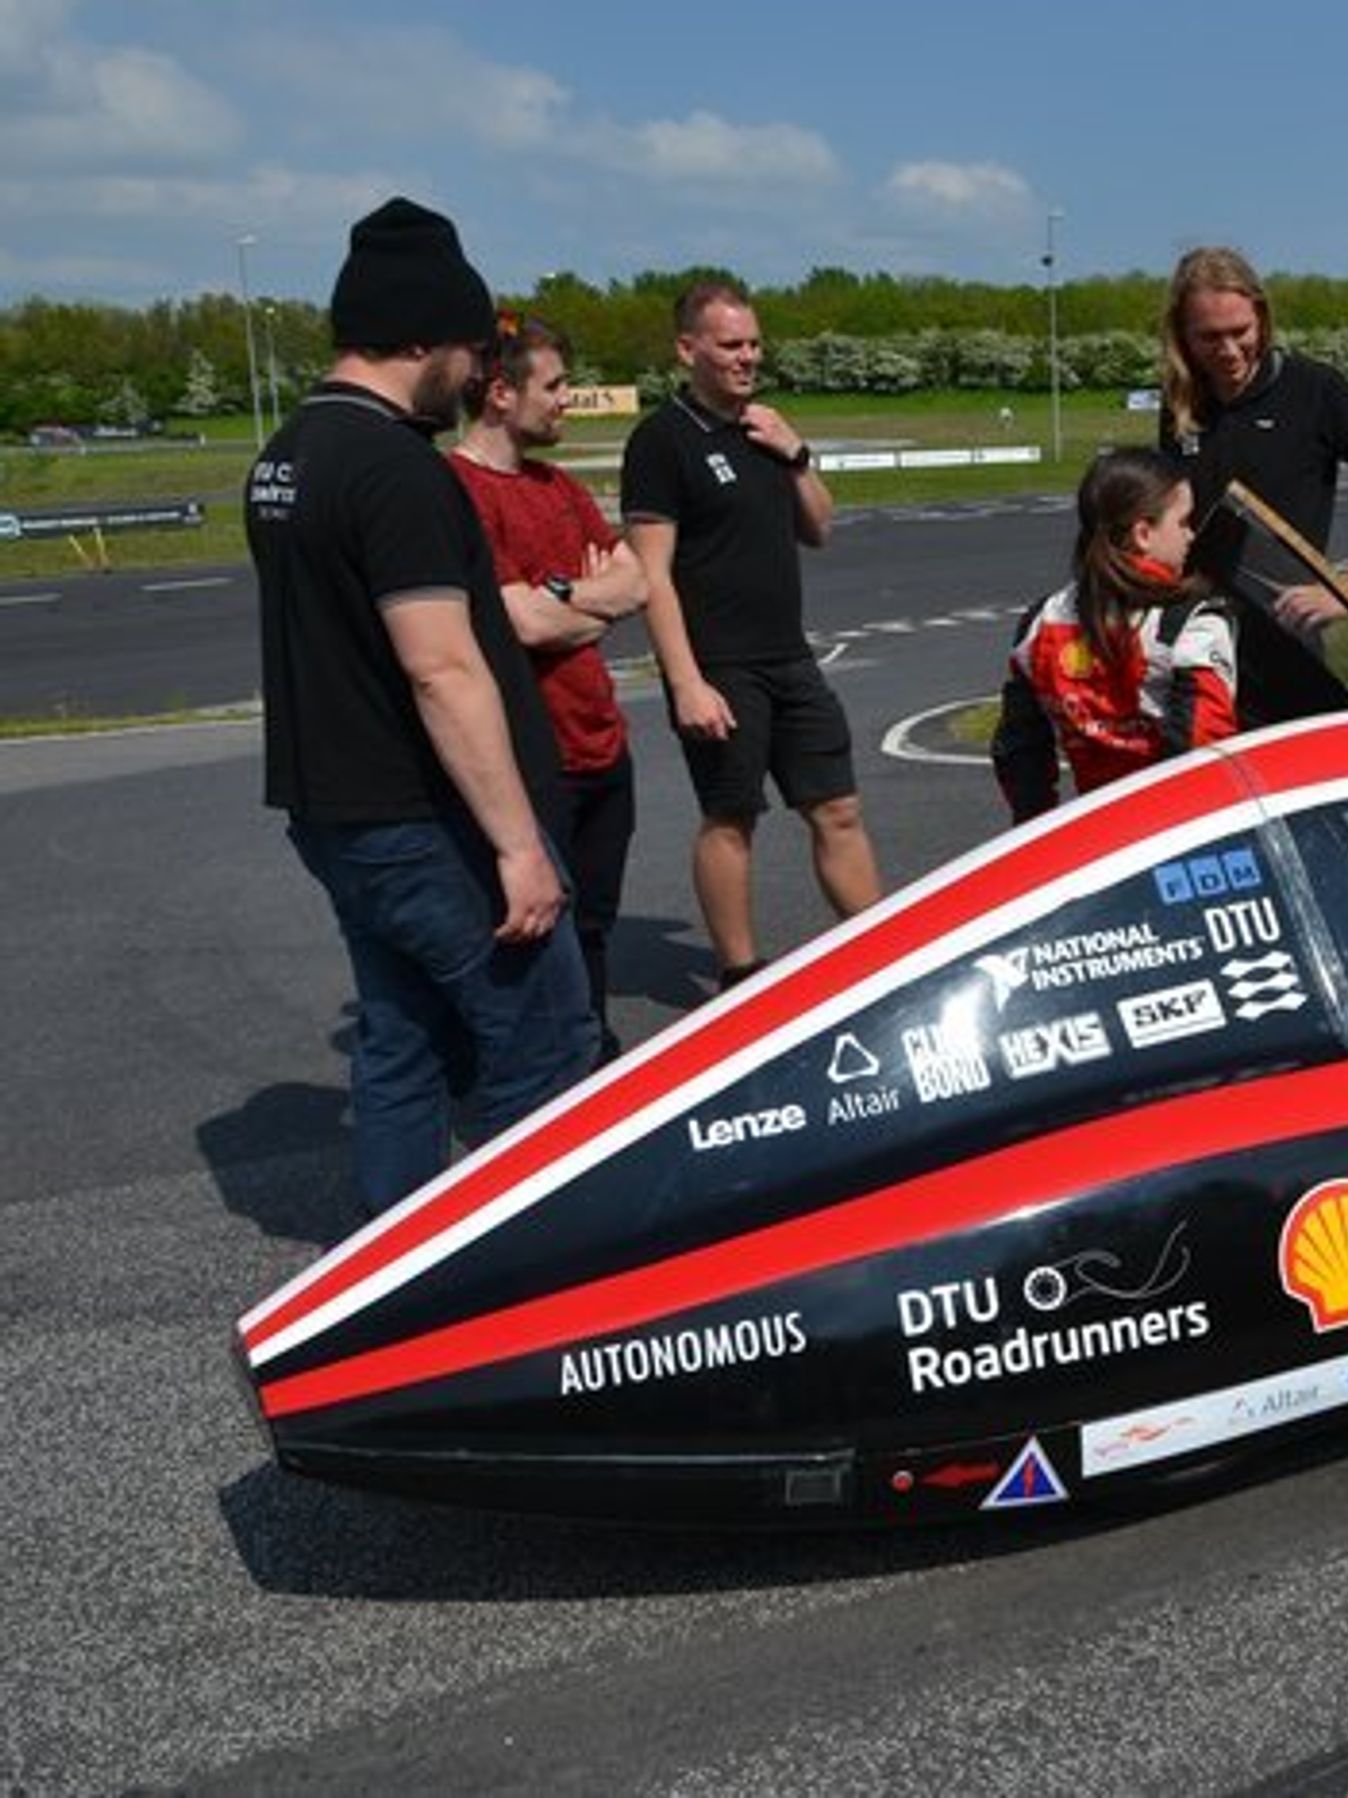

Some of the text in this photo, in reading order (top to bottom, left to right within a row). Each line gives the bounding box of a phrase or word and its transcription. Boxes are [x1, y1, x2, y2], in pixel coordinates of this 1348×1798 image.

[1160, 858, 1258, 900] FDM
[1031, 922, 1160, 965] NATIONAL
[1204, 897, 1281, 953] DTU
[1031, 938, 1204, 991] INSTRUMENTS
[1132, 989, 1207, 1028] SKF
[1000, 1012, 1111, 1076] HEXIS
[827, 1086, 900, 1126] Altair
[912, 1058, 991, 1104] BOND
[688, 1103, 807, 1150] Lenze
[897, 1276, 1000, 1337] DTU
[560, 1311, 807, 1396] AUTONOMOUS
[907, 1300, 1210, 1392] Roadrunners
